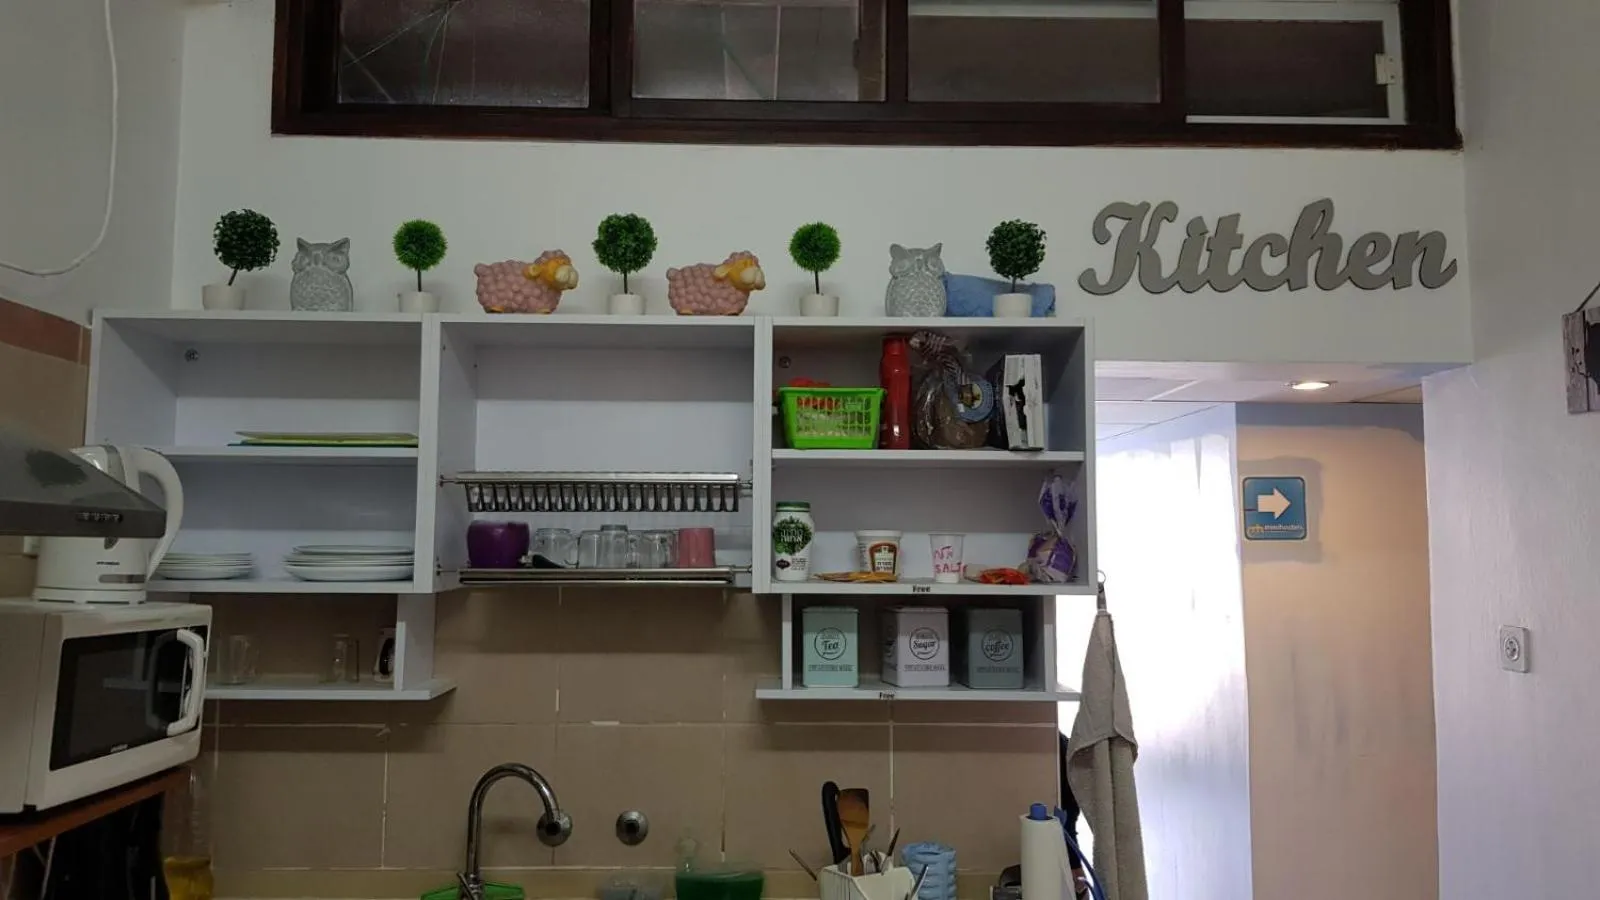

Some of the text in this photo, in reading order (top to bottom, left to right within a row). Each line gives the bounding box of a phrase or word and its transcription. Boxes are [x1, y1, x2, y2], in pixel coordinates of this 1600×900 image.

[1078, 197, 1458, 296] Kitchen
[912, 585, 931, 593] Free
[822, 640, 839, 651] Tea
[913, 640, 936, 651] Sugar
[879, 691, 896, 699] Free
